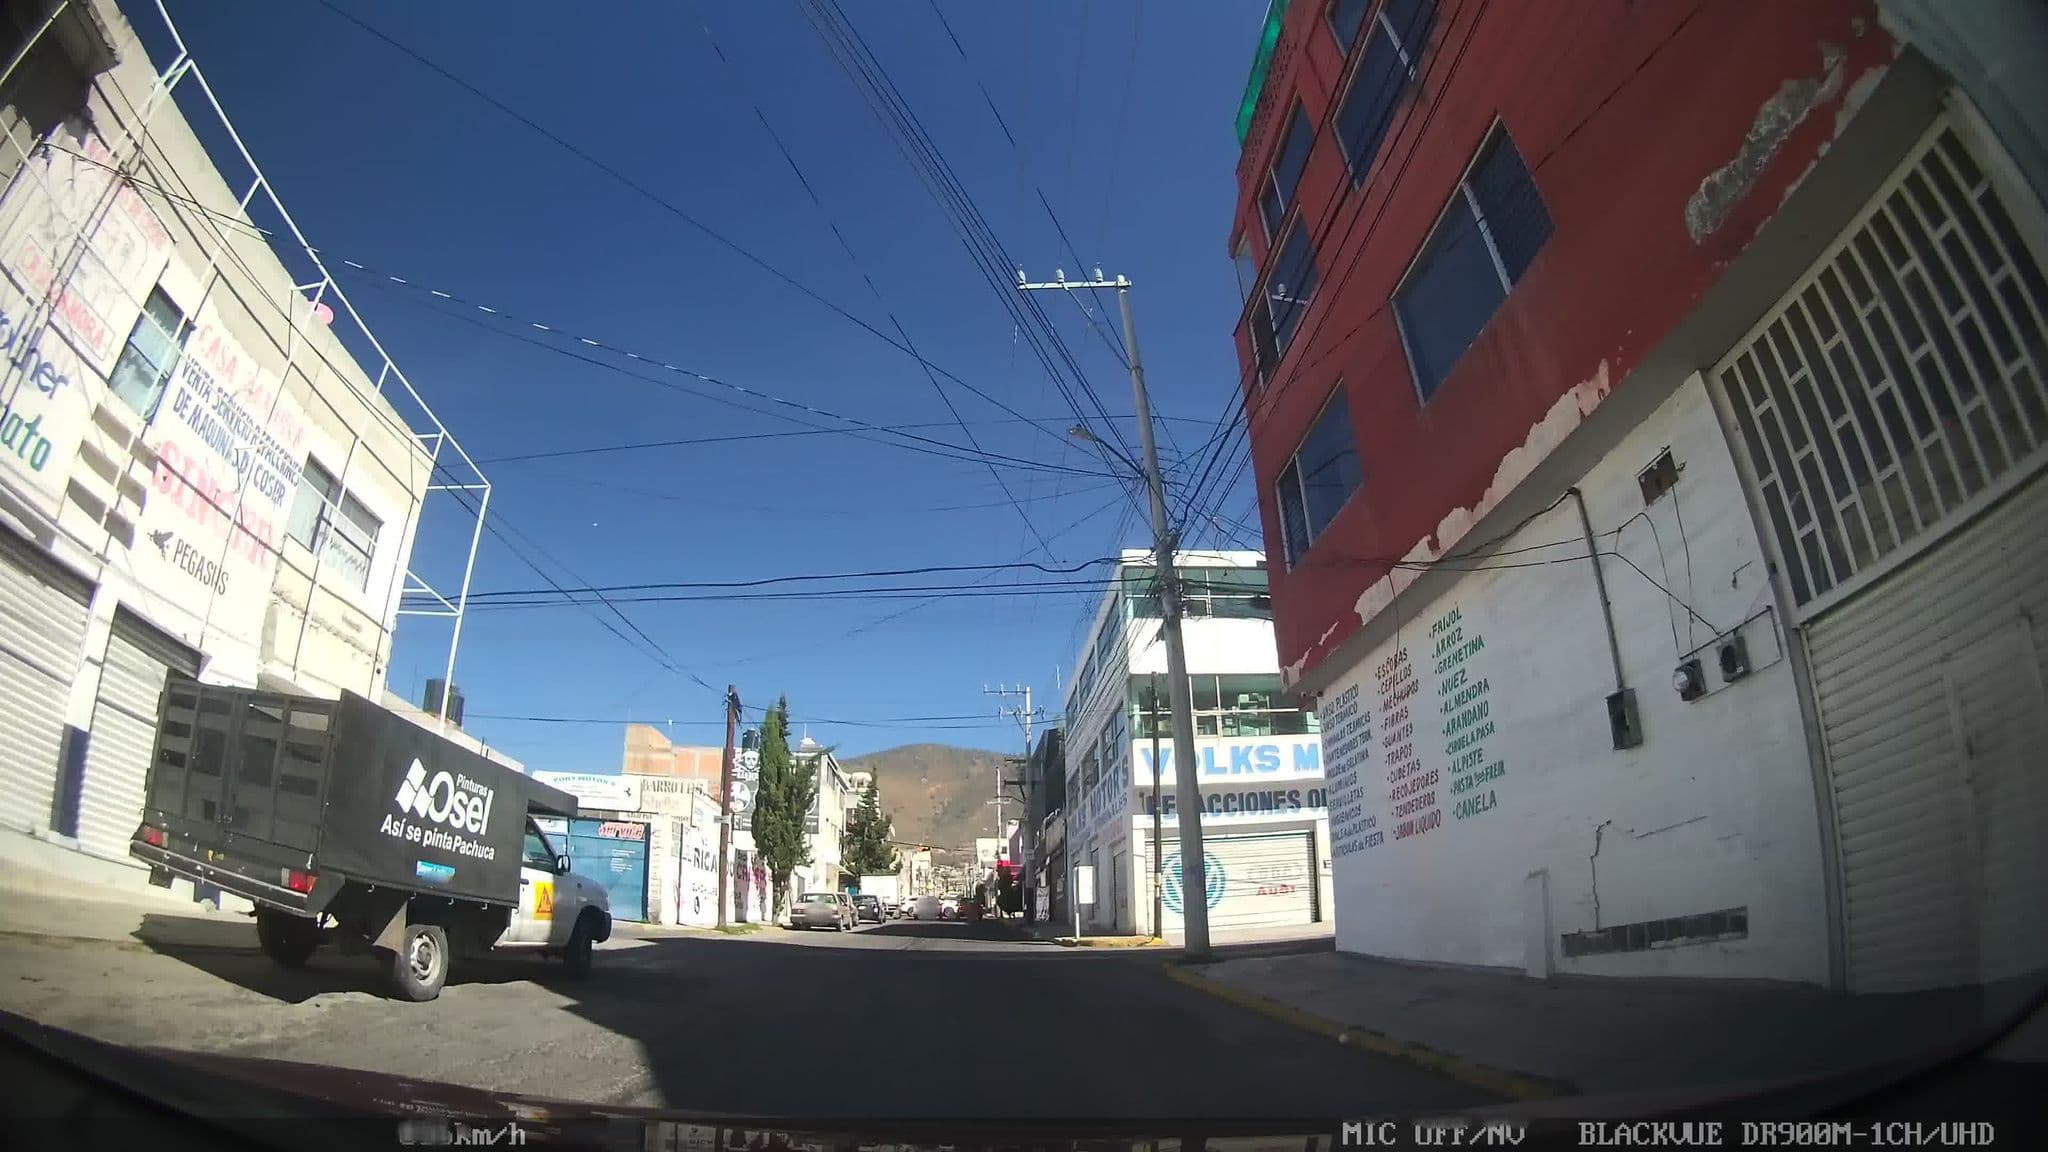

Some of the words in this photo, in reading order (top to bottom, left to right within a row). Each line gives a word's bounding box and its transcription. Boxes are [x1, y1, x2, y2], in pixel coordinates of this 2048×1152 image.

[173, 382, 189, 421] DE
[172, 536, 230, 597] PEGASUS
[1431, 607, 1463, 639] FRIJOL
[1435, 627, 1464, 658] ARROZ
[1437, 634, 1485, 674] GRENETINA
[1377, 647, 1409, 681] ESCOBAS
[1380, 663, 1413, 696] CEPILLOS
[1383, 679, 1420, 712] MECHUDOS
[1441, 668, 1469, 697] NUEZ
[1444, 678, 1491, 716] ALMENDRA
[1384, 705, 1410, 732] FIBRAS
[1446, 700, 1490, 737] ARANDANO
[1475, 720, 1496, 744] PASA
[1140, 744, 1281, 776] VLKS
[1387, 743, 1413, 769] TRAPOS
[1390, 758, 1421, 784] CUBETAS
[1451, 747, 1485, 775] ALPISTE
[456, 772, 488, 797] Pinturas
[1453, 774, 1476, 797] PASTA
[429, 770, 495, 836] Osel
[1144, 788, 1301, 818] REACCIONES
[1456, 789, 1498, 821] CANELA
[380, 813, 407, 838] Así
[405, 824, 422, 842] se
[422, 827, 454, 850] pinta
[452, 834, 496, 861] Pachuca
[1414, 808, 1442, 835] LIQUIDO
